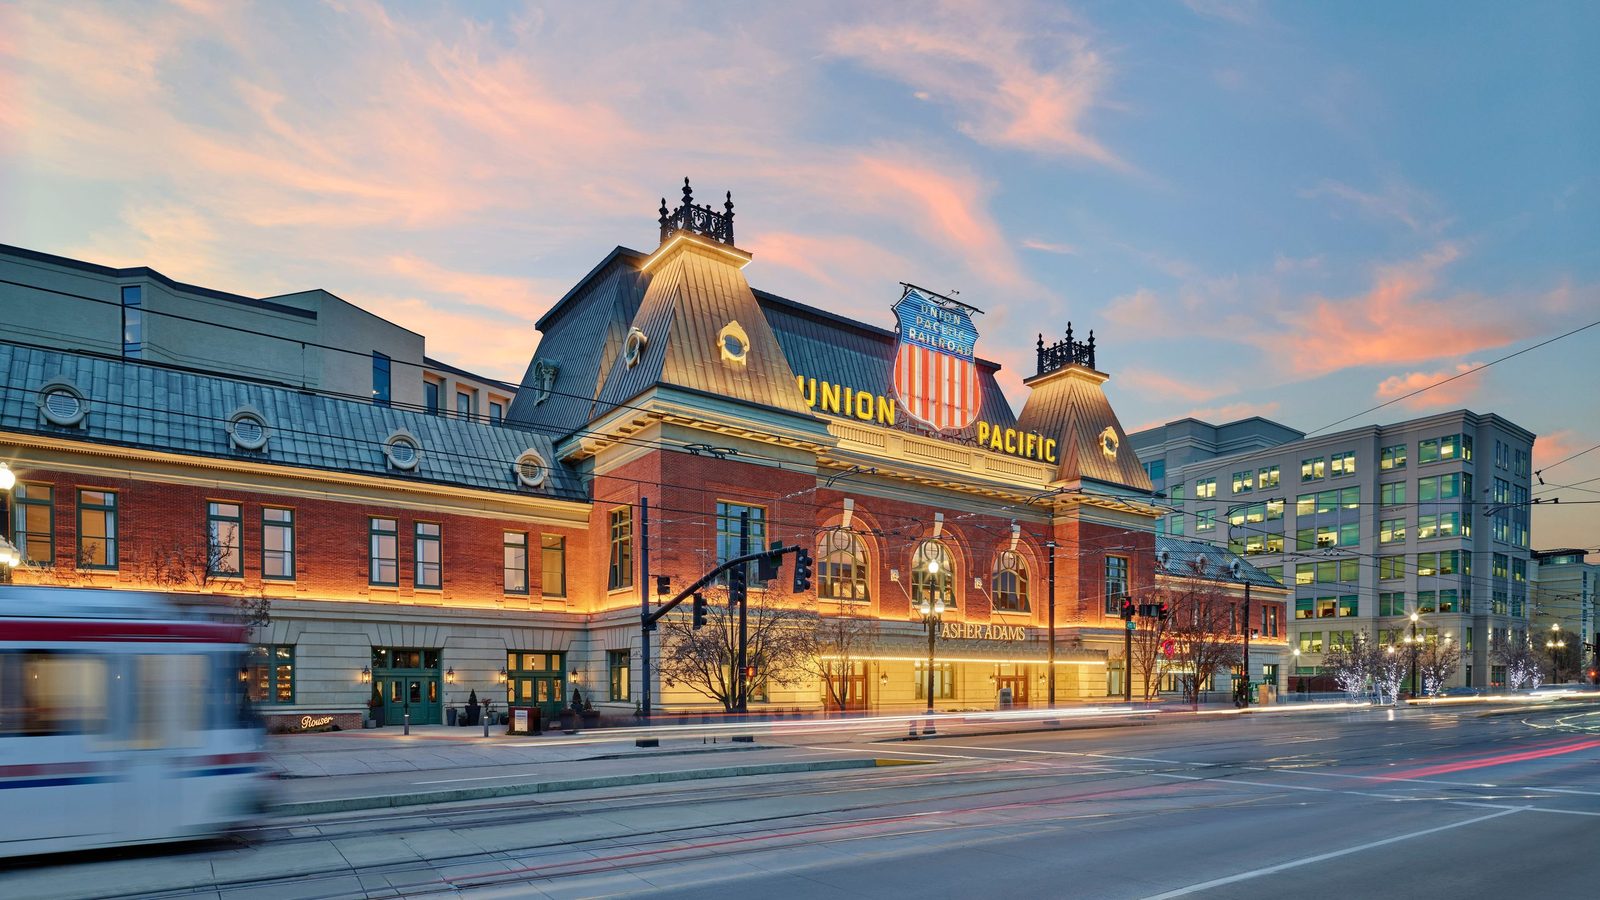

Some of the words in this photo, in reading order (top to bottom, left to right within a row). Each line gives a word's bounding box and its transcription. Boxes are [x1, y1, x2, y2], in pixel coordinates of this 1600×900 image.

[921, 303, 961, 325] UNION
[916, 315, 965, 340] PACIFIC
[909, 327, 972, 355] RAILROAD
[796, 375, 895, 426] UNION
[976, 421, 1056, 462] PACIFIC
[941, 623, 982, 639] ASHER
[984, 624, 1025, 641] ADAMS
[301, 715, 334, 729] Rouser
